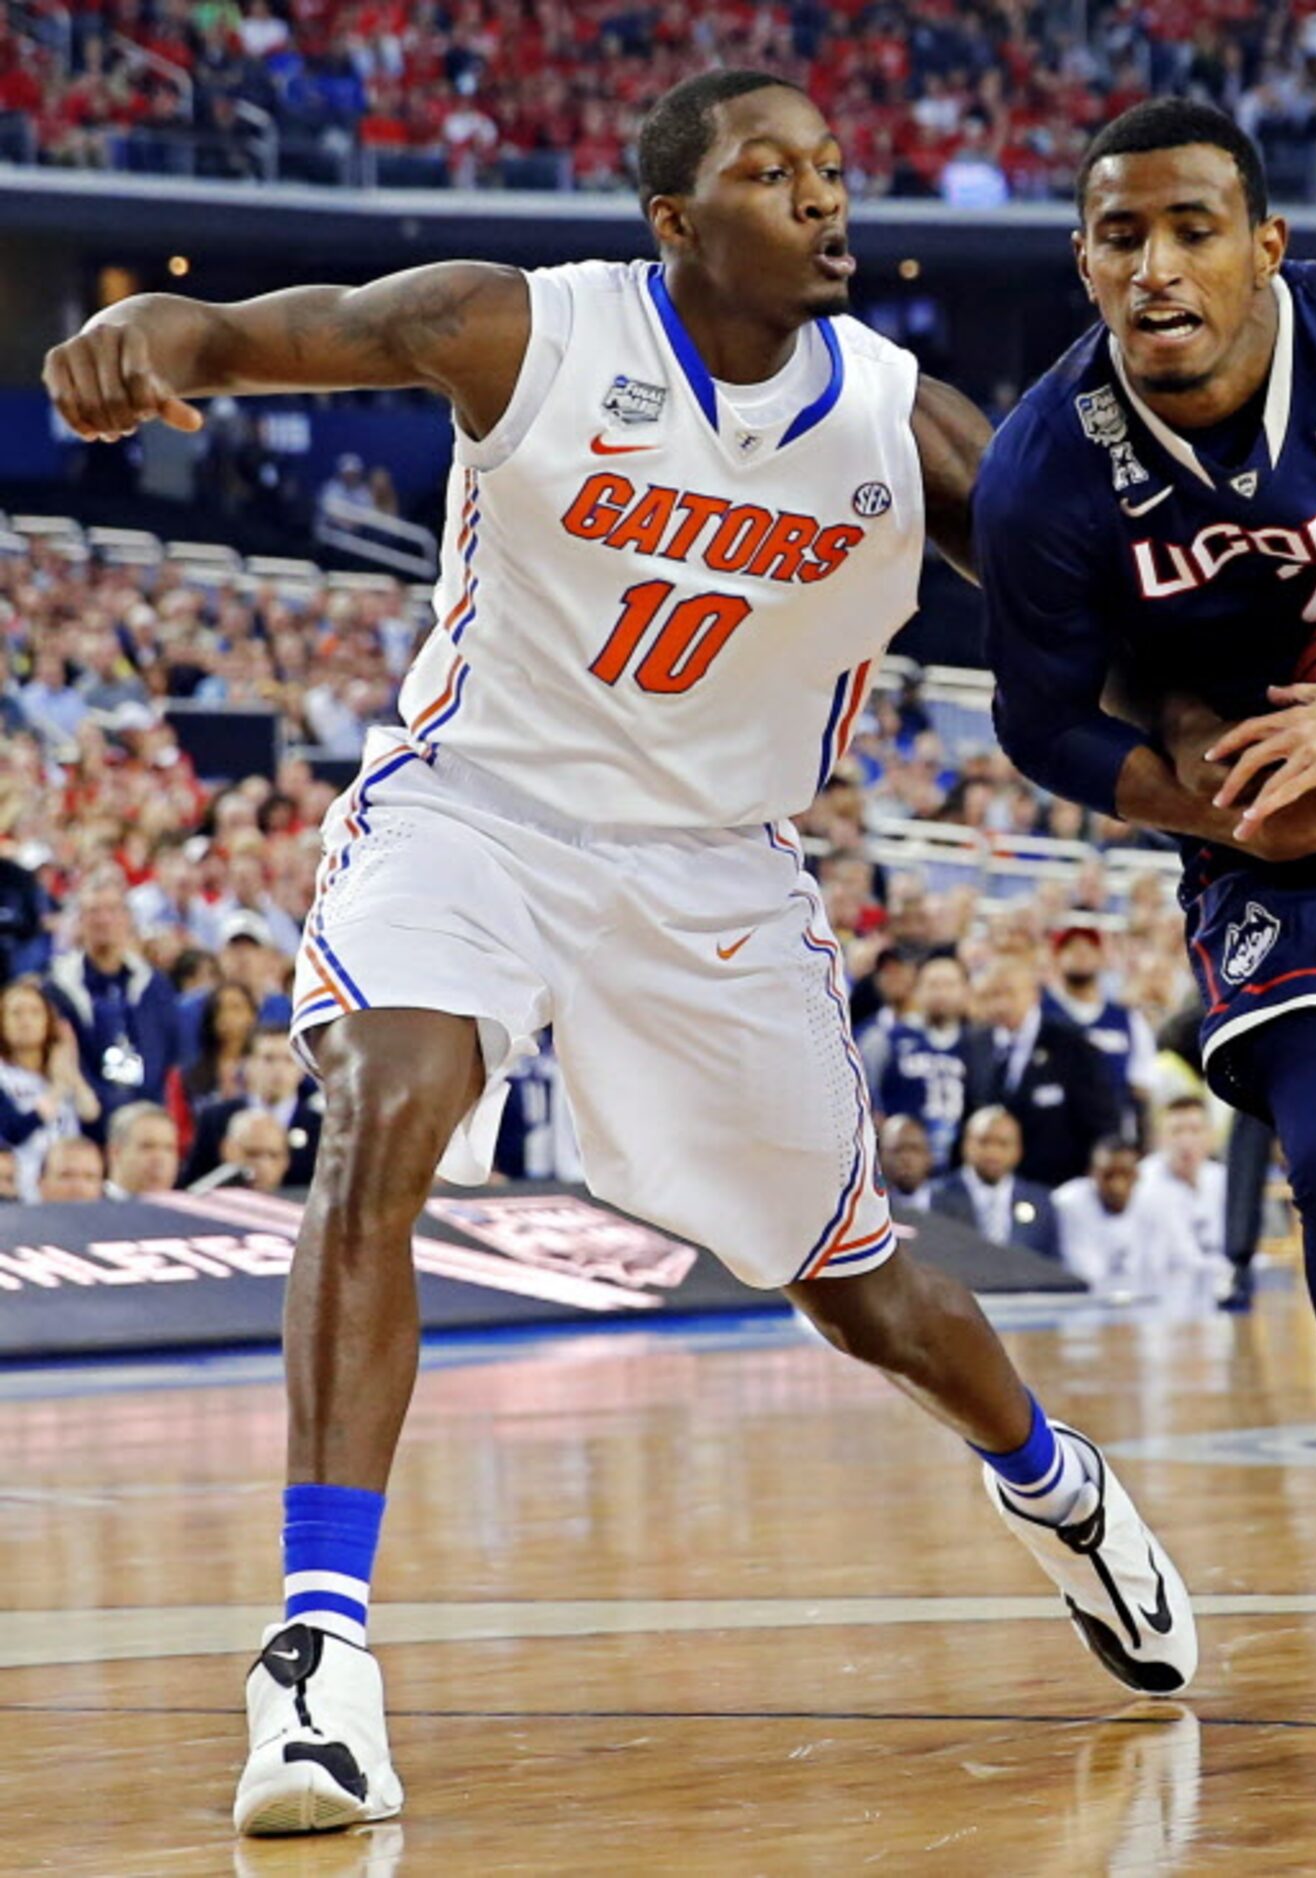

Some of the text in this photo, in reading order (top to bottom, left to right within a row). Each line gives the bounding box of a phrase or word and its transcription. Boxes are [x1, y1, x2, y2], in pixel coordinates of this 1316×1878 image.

[561, 472, 865, 583] GATORS
[856, 485, 890, 515] SEC
[588, 578, 753, 694] 10
